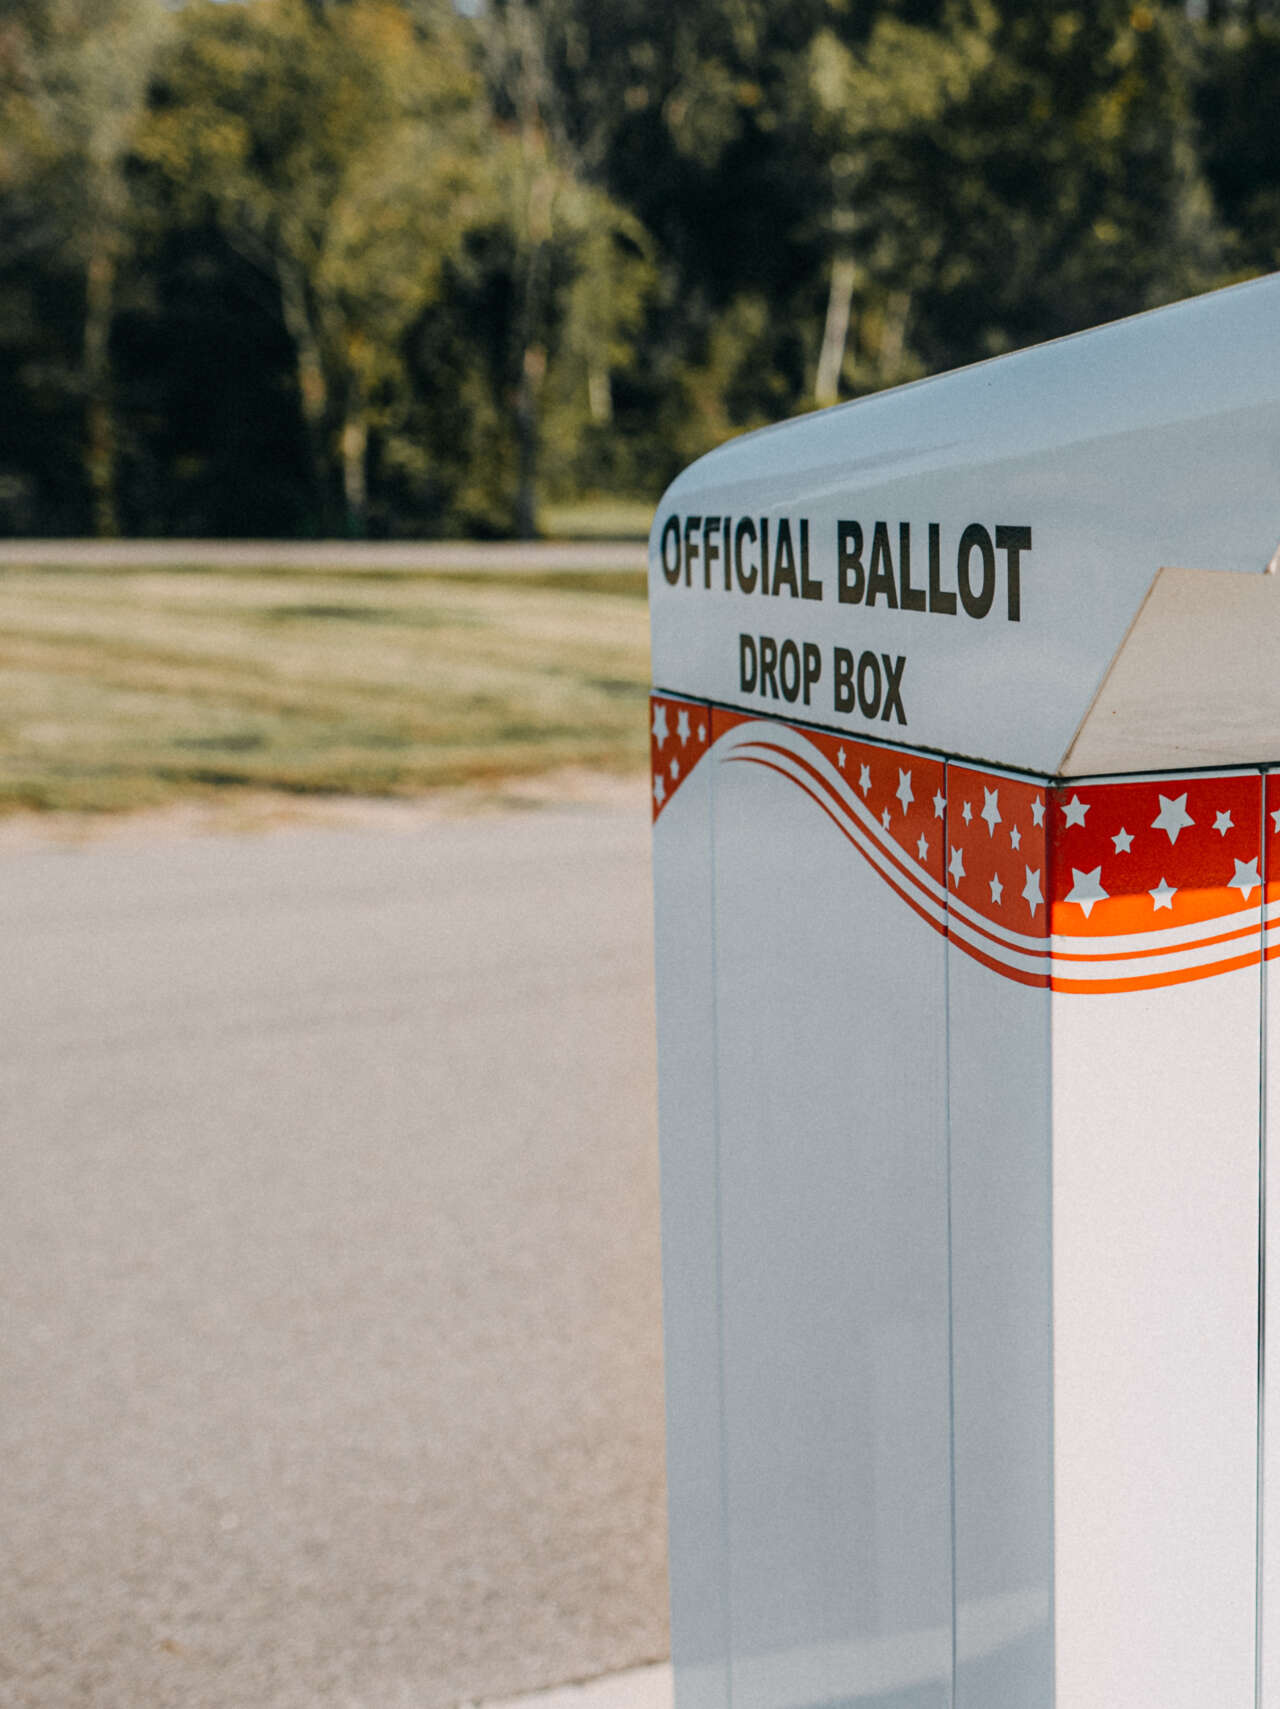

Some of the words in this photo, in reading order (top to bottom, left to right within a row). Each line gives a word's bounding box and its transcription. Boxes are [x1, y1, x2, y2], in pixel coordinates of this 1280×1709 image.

[660, 513, 824, 602] OFFICIAL
[837, 519, 1033, 623] BALLOT
[739, 633, 822, 706] DROP
[833, 646, 908, 726] BOX
